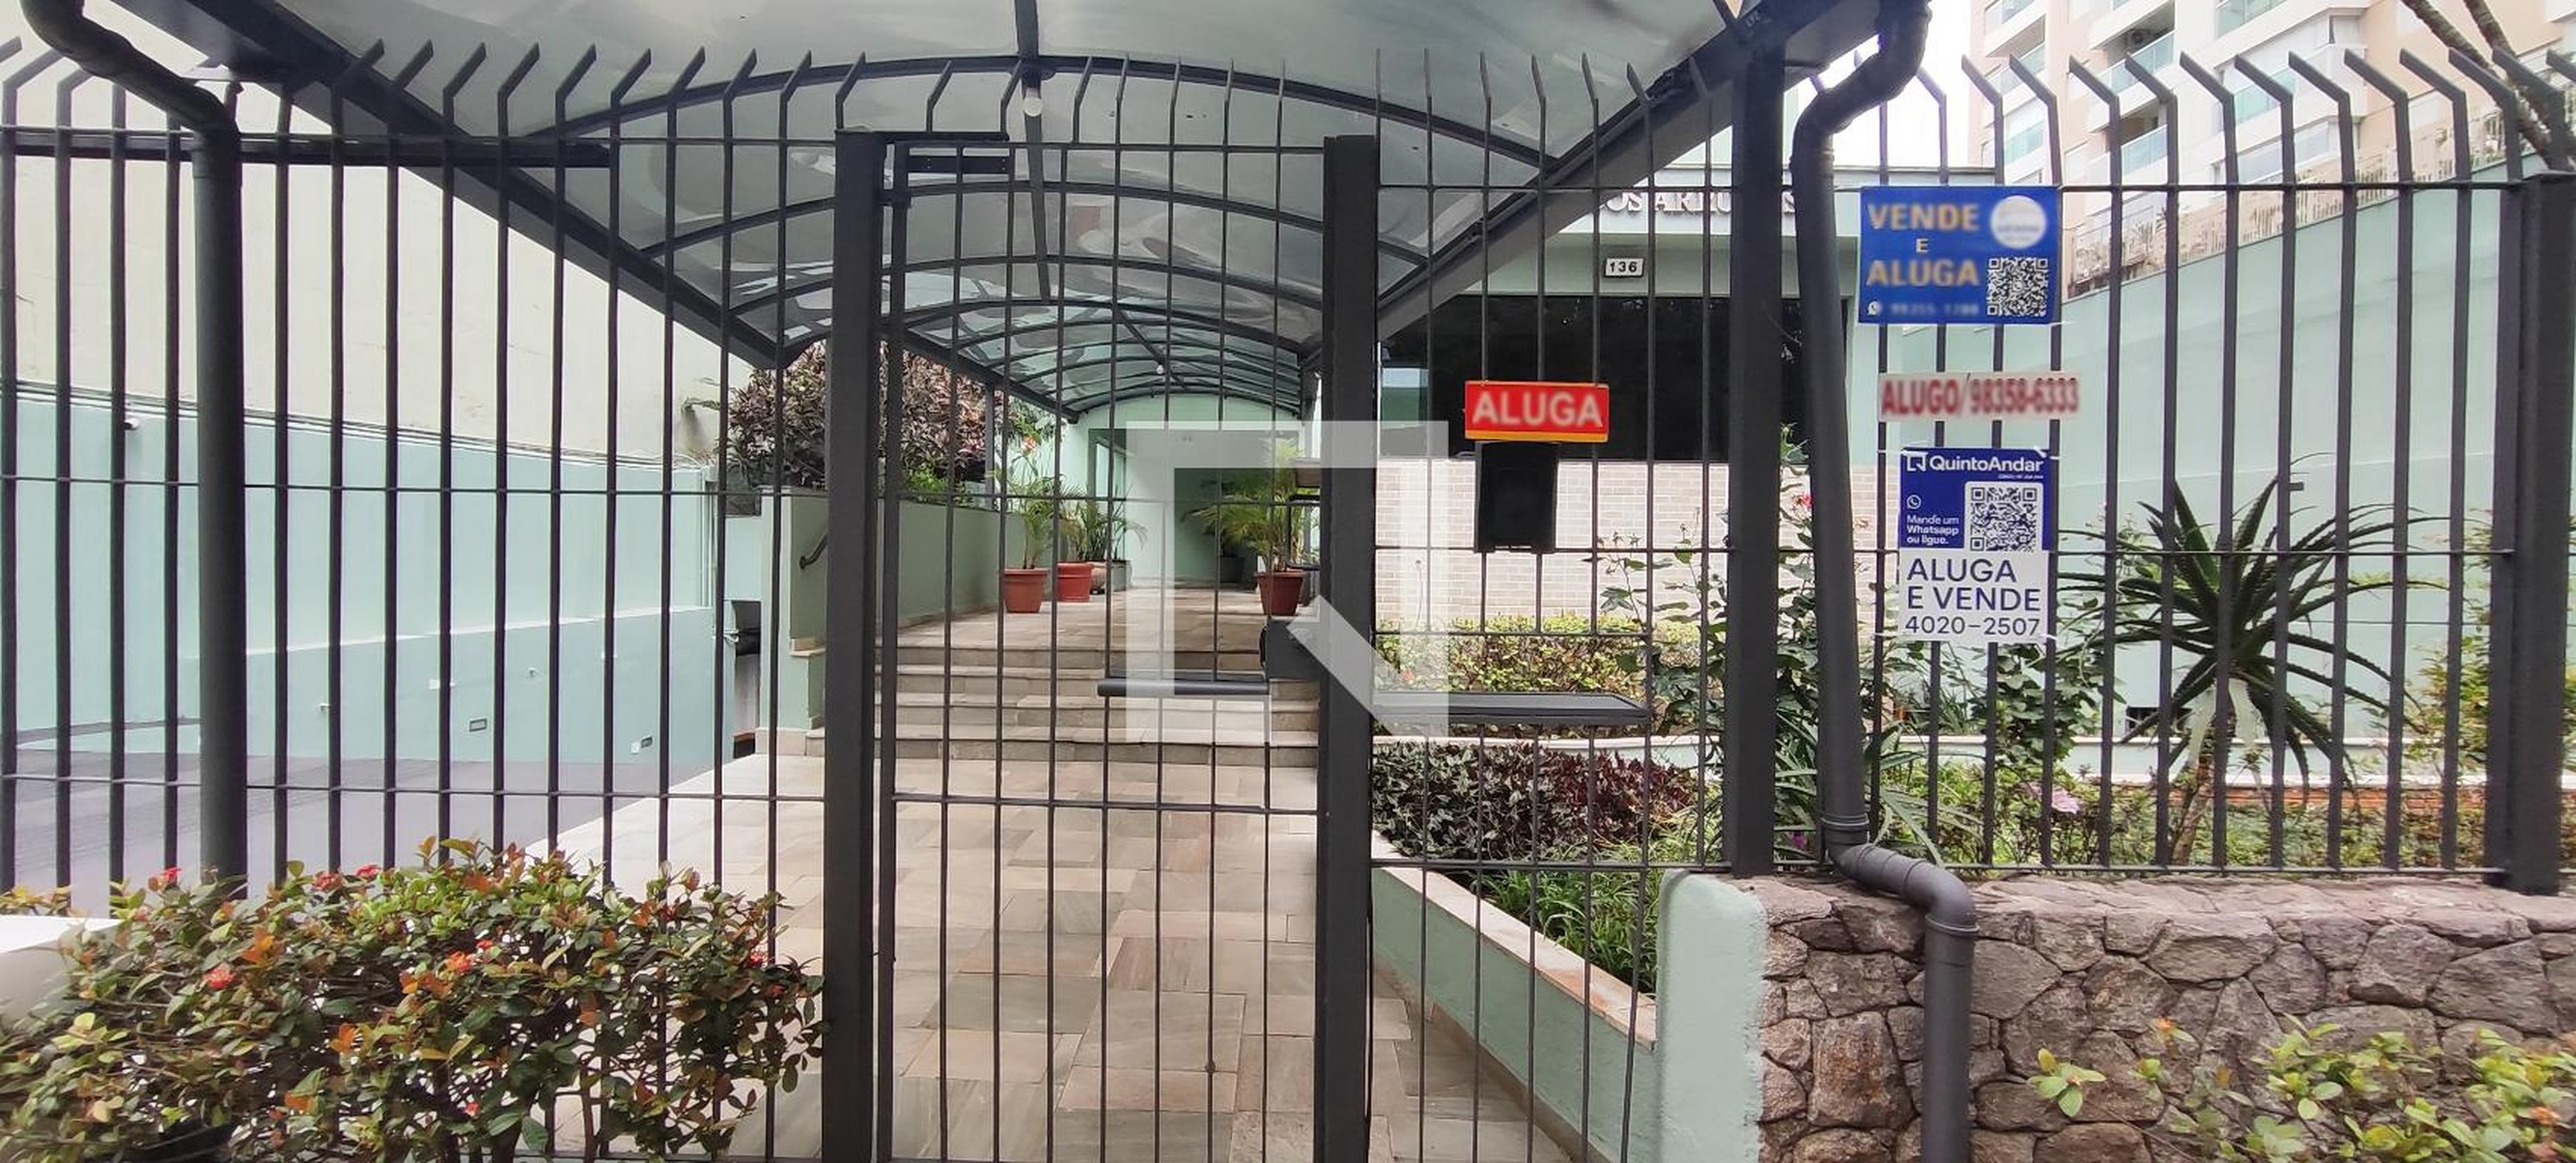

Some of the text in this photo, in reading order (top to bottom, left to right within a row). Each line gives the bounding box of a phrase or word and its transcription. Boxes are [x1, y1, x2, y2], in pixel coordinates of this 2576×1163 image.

[1867, 203, 1978, 230] VENDE
[1915, 238, 1929, 254] E
[1609, 262, 1638, 272] 136
[1866, 260, 1978, 287] ALUGA
[1472, 392, 1603, 427] ALUGA
[1929, 455, 2044, 472] QuintoAndar
[1907, 514, 1941, 524] Mande
[1907, 524, 1960, 536] Whatsapp
[1907, 558, 2017, 583] ALUGA
[1908, 586, 2041, 611] E VENDE
[1905, 615, 2040, 636] 4020-2507
